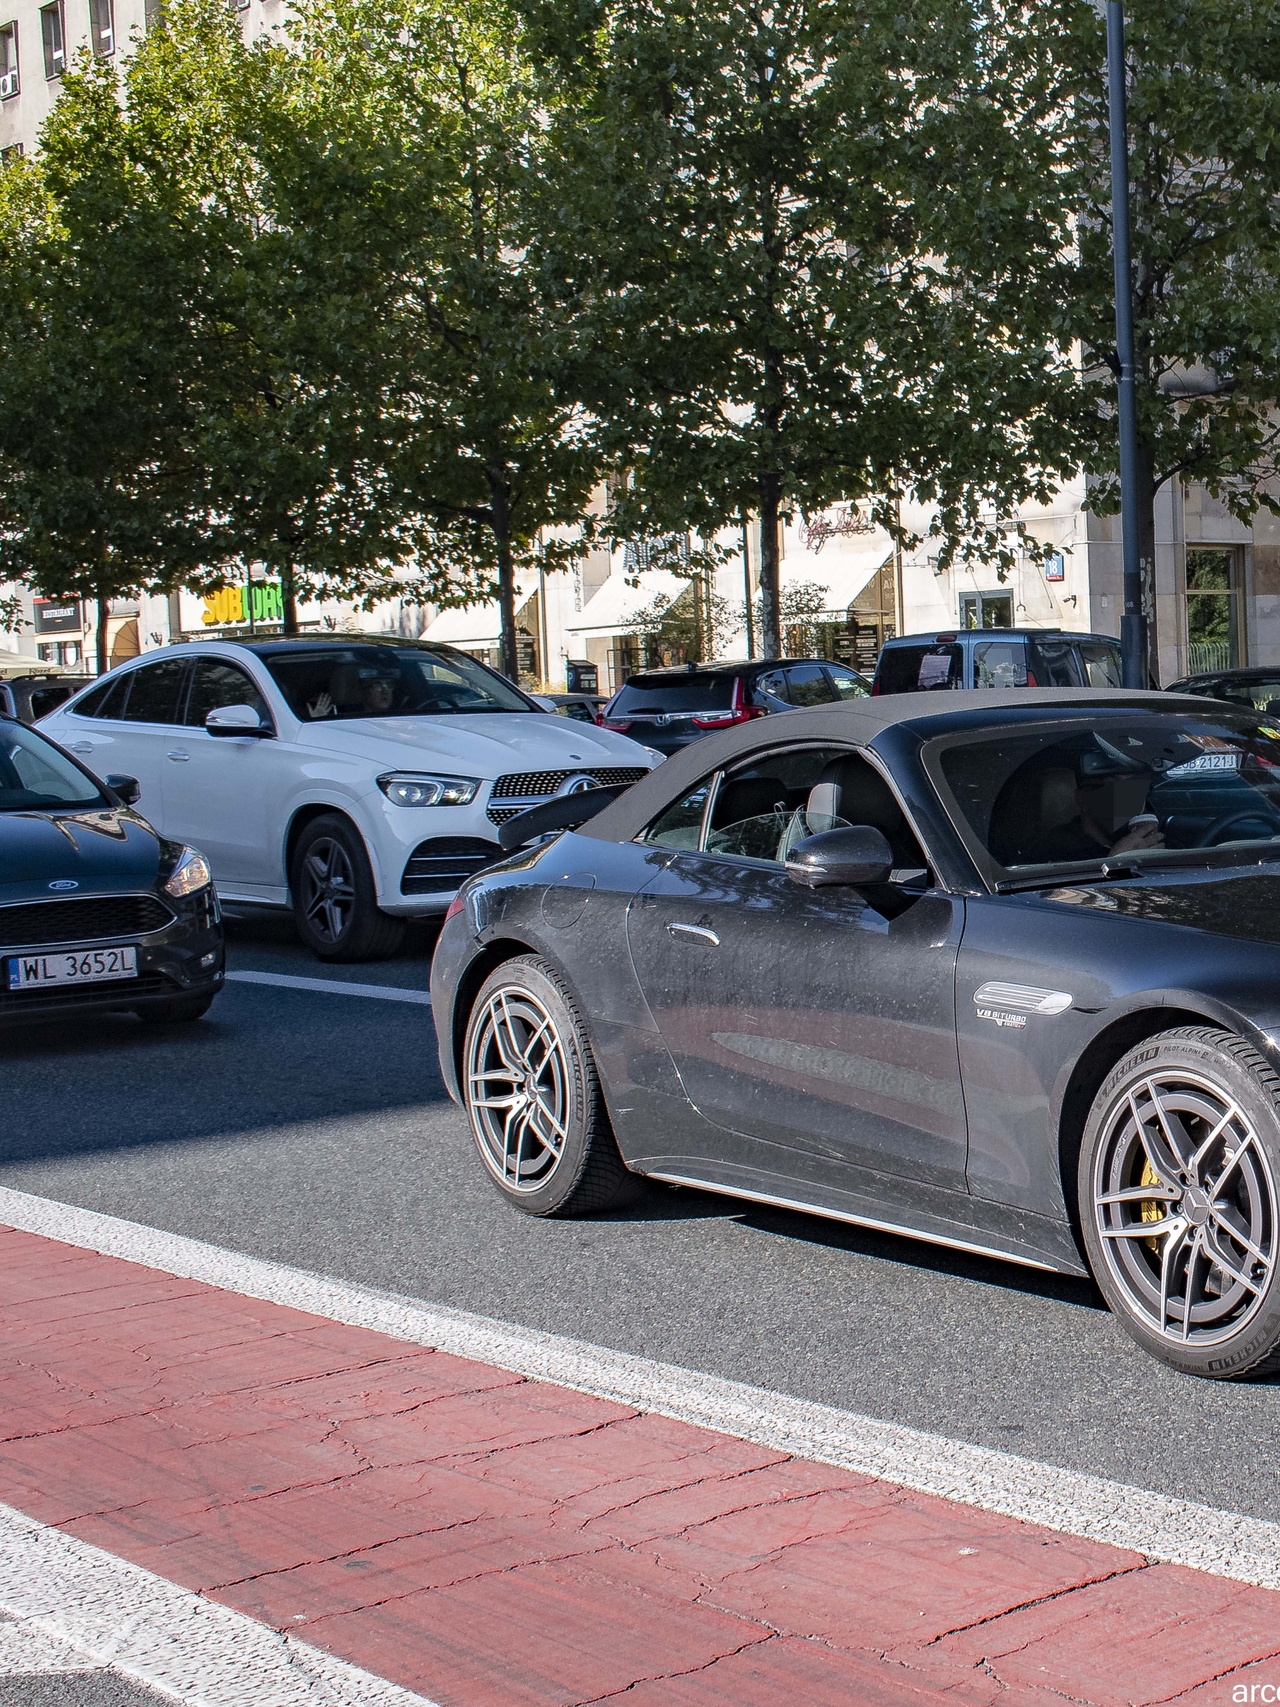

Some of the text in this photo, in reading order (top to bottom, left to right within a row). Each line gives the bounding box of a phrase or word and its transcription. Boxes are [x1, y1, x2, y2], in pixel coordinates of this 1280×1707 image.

[1048, 560, 1058, 574] 18
[24, 958, 57, 980] WL
[66, 950, 134, 977] 3652L
[976, 1008, 1027, 1023] V8 BITURBO
[1106, 1046, 1158, 1094] MICHELIN
[1211, 1329, 1268, 1371] MICHELIN
